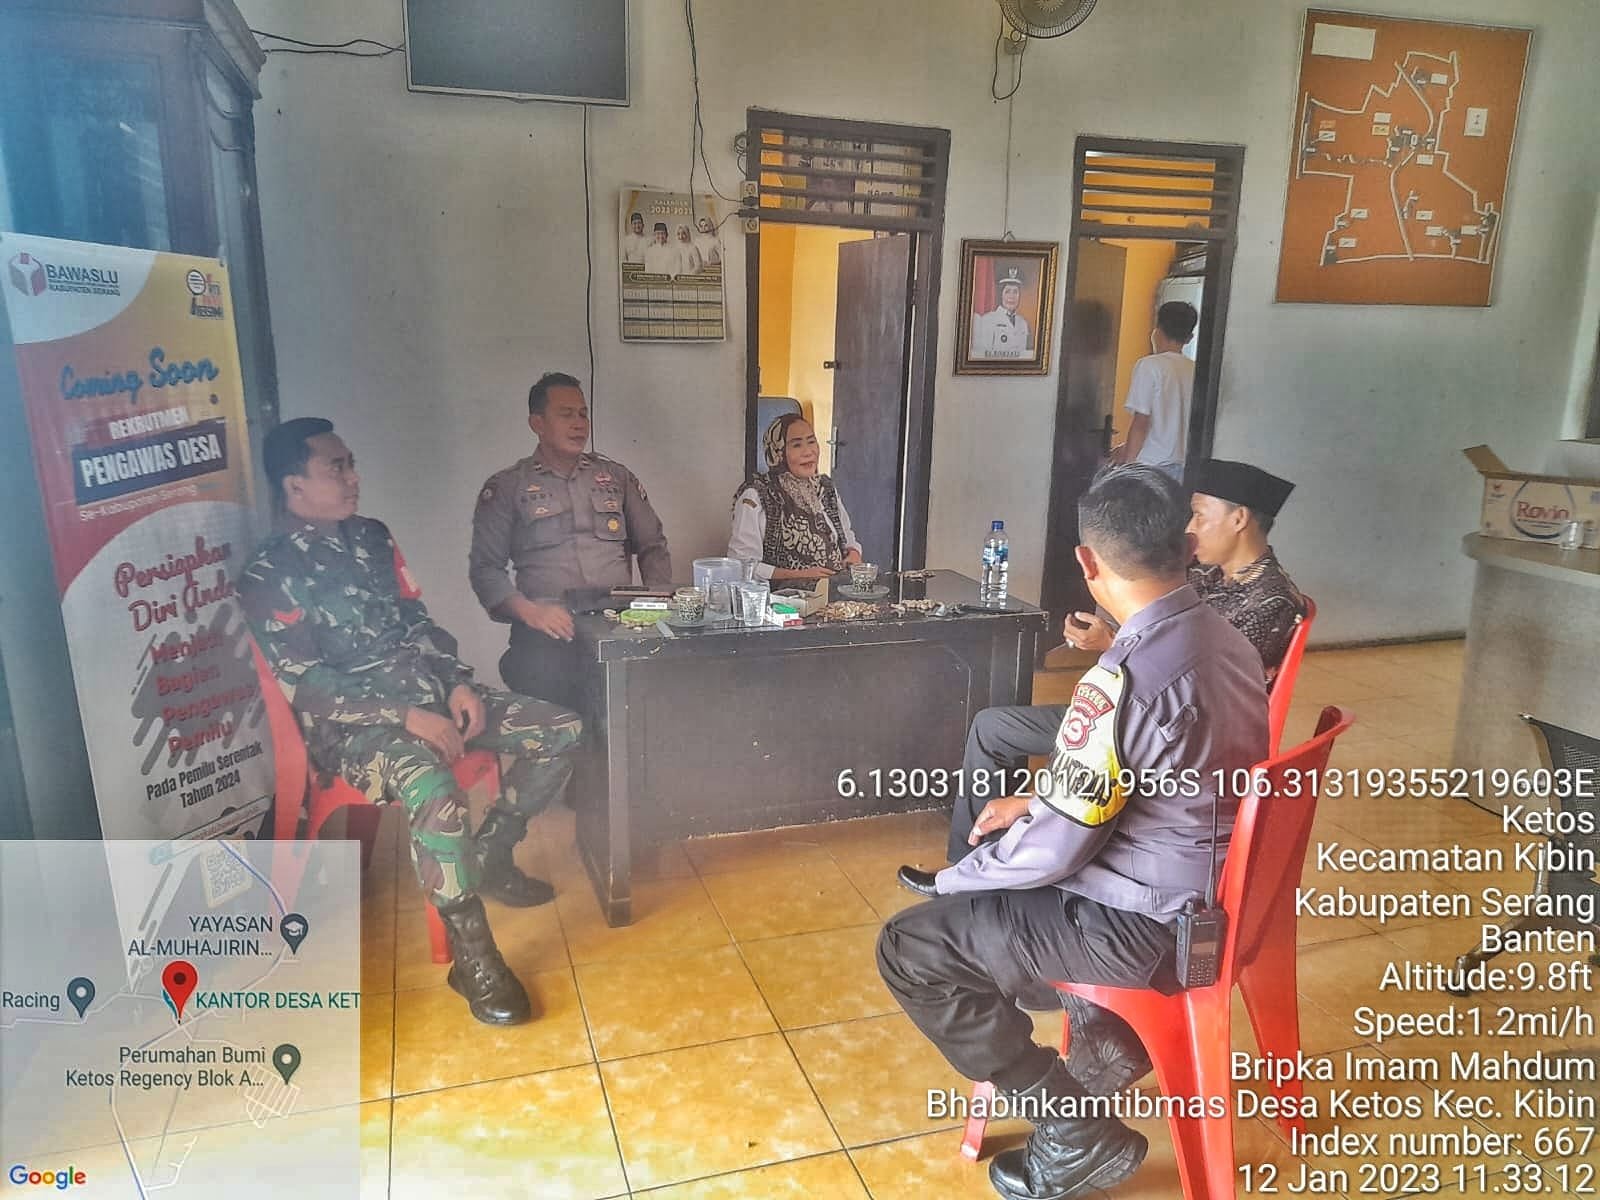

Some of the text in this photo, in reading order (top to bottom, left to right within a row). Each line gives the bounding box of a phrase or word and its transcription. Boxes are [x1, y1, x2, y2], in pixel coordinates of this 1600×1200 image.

[45, 264, 119, 284] BAWASLU
[60, 346, 219, 404] Coming Soon
[109, 405, 189, 440] REKRUTMEN
[80, 433, 222, 488] PENGAWAS DESA
[128, 594, 178, 631] Diri
[168, 719, 234, 757] Pemilu
[146, 777, 177, 800] Pada
[178, 761, 216, 787] Pemilu
[180, 769, 241, 808] Tahun 2024
